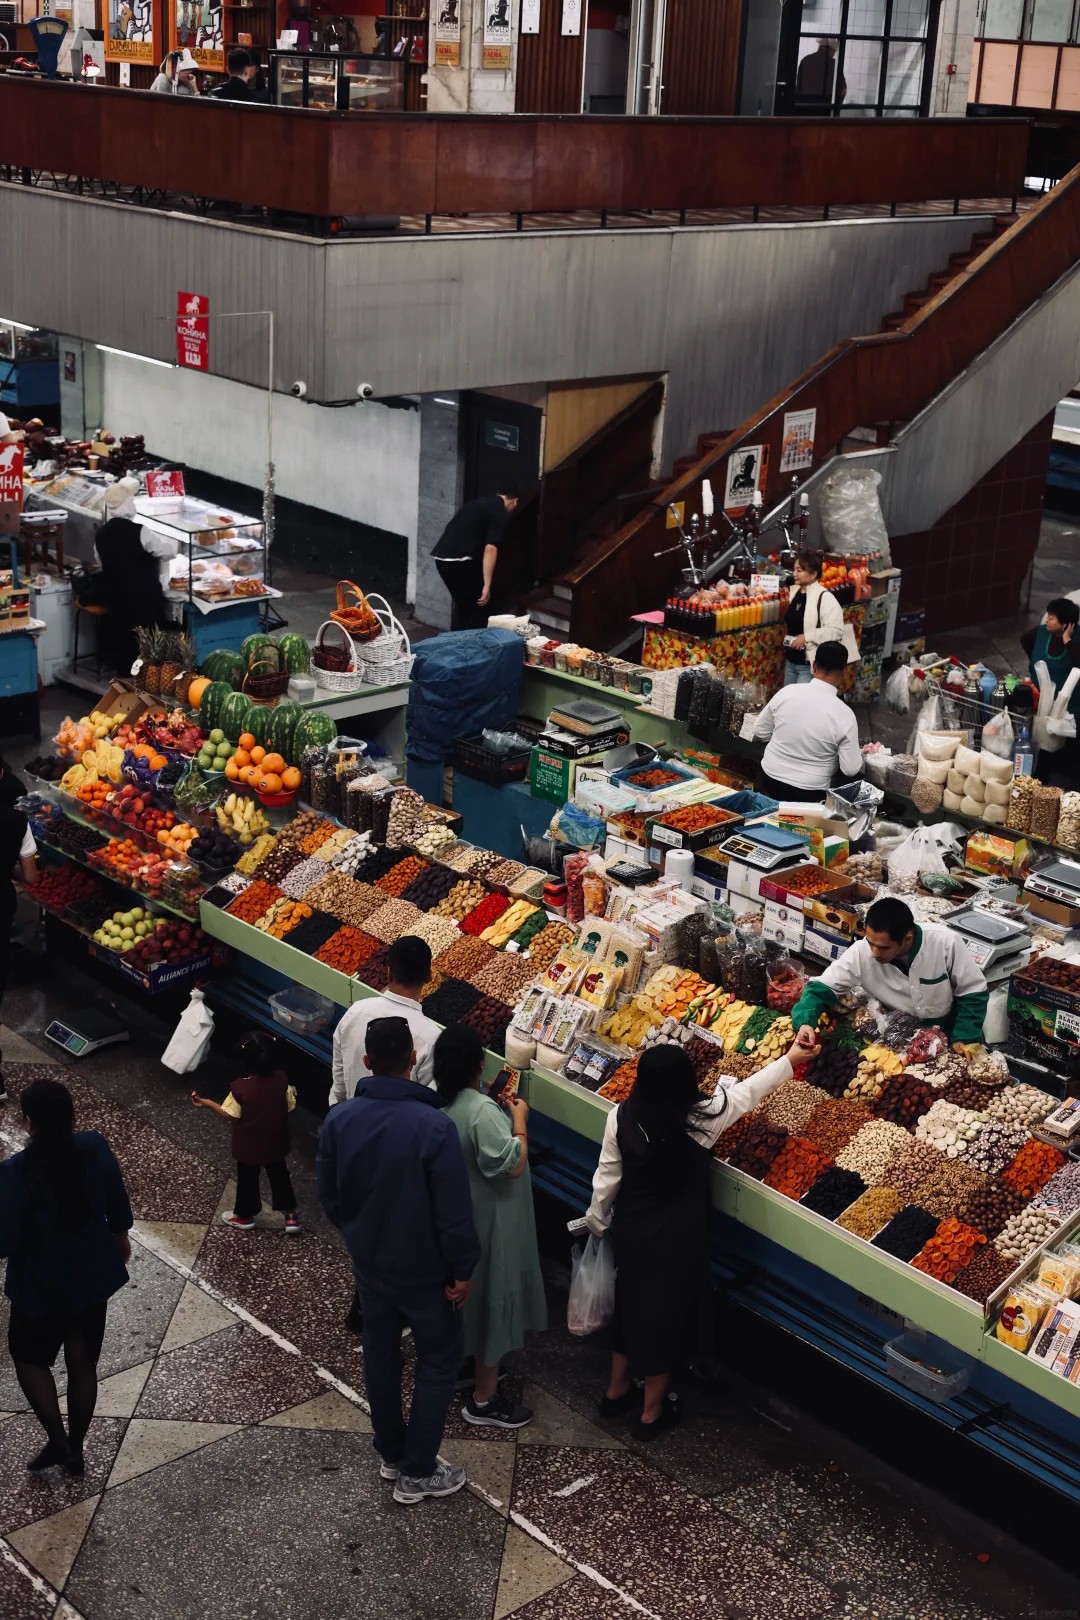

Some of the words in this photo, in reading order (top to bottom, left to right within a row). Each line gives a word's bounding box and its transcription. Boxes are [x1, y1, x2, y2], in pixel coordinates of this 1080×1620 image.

[177, 326, 206, 340] КОНИНА
[790, 916, 802, 925] KING
[158, 966, 190, 983] ALLIANCE
[191, 957, 211, 971] FRUIT
[1057, 1020, 1080, 1033] RAISINS
[1058, 1014, 1080, 1028] BLACK
[430, 1476, 440, 1486] N
